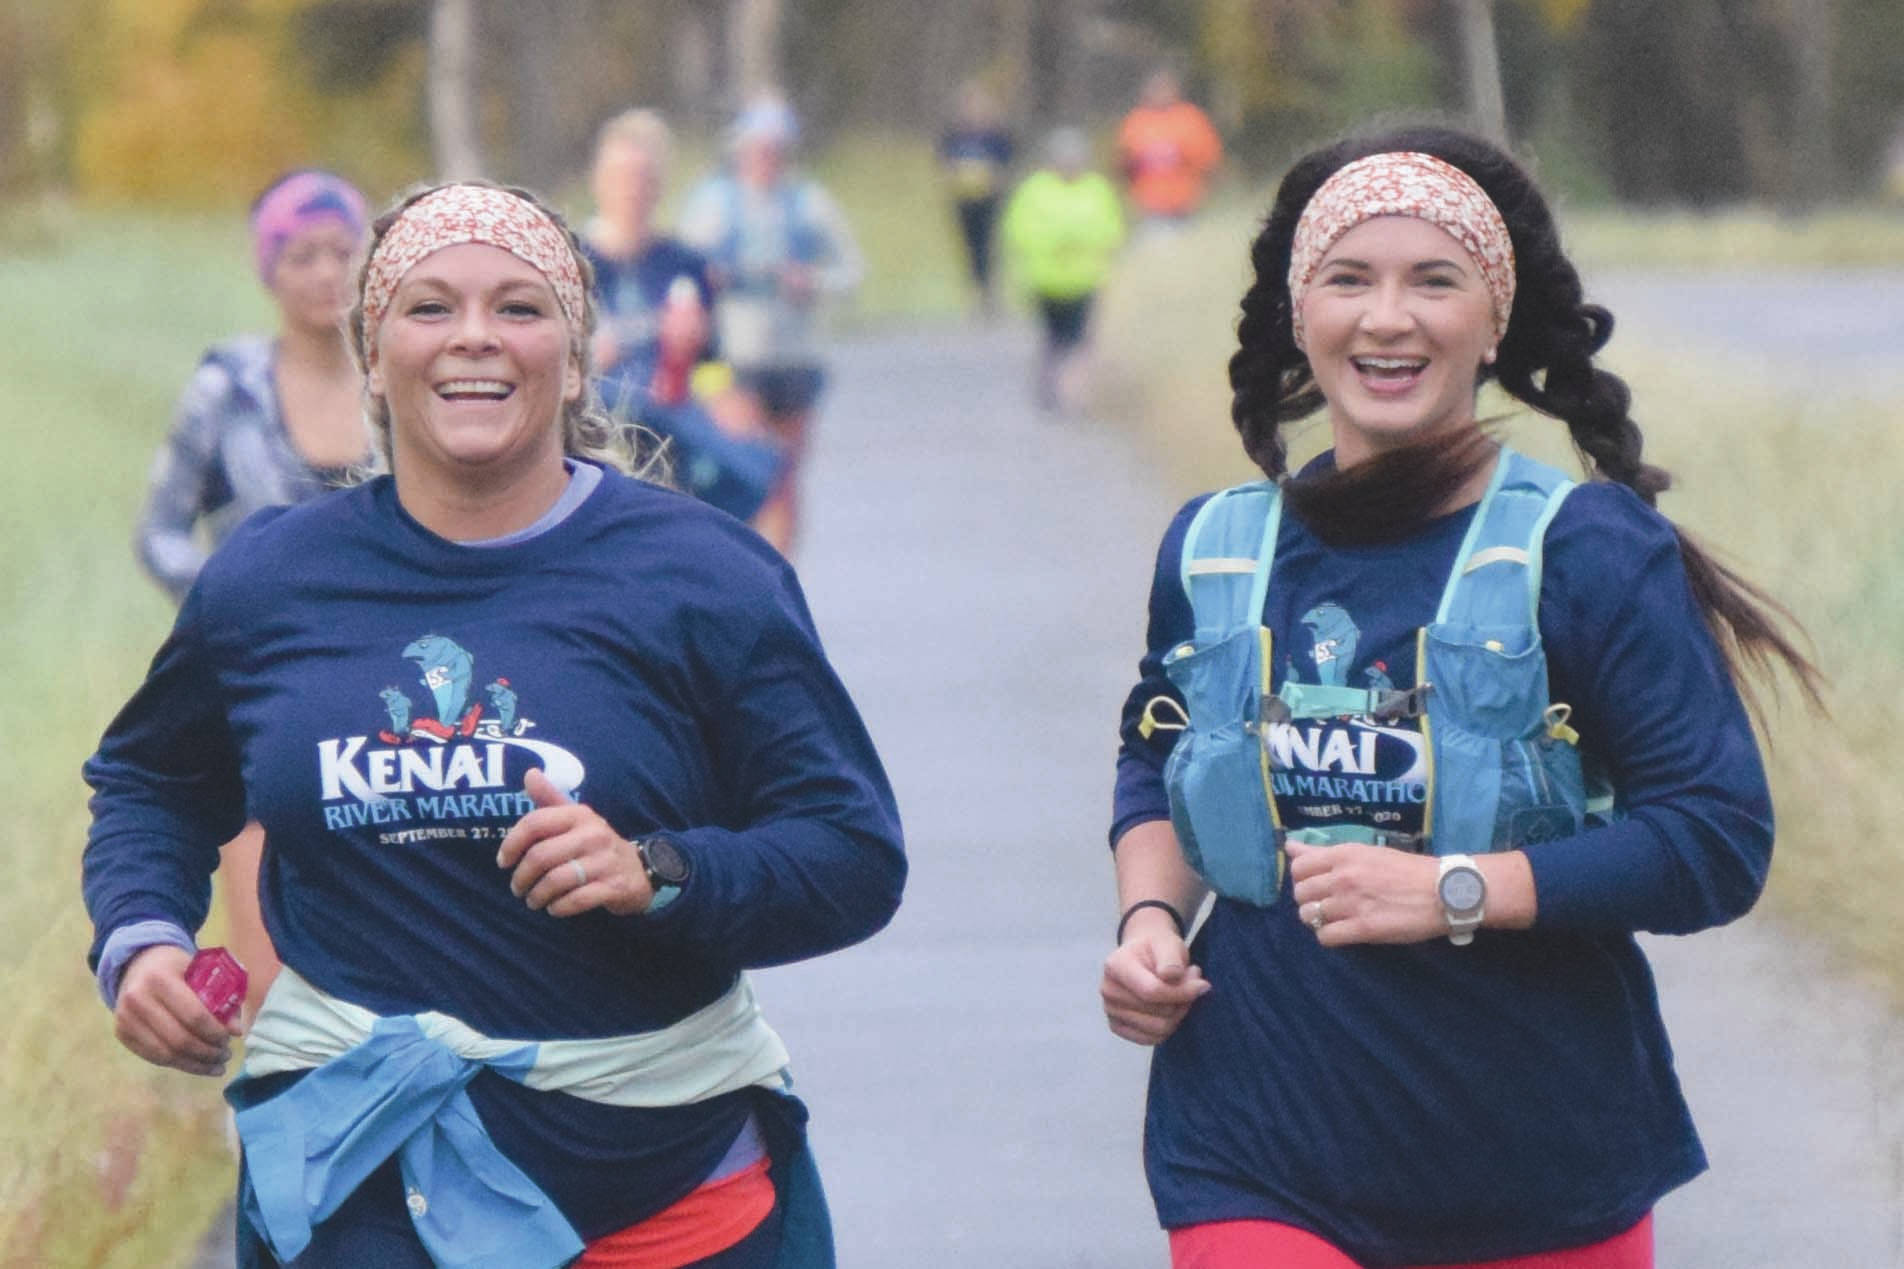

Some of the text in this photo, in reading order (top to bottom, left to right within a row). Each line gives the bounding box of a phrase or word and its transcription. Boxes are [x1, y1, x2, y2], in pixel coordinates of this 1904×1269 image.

[317, 736, 506, 801] KENAI
[1296, 775, 1426, 804] MARATHO
[324, 791, 581, 830] RIVER MARATH
[379, 827, 468, 845] SEPTEMBER
